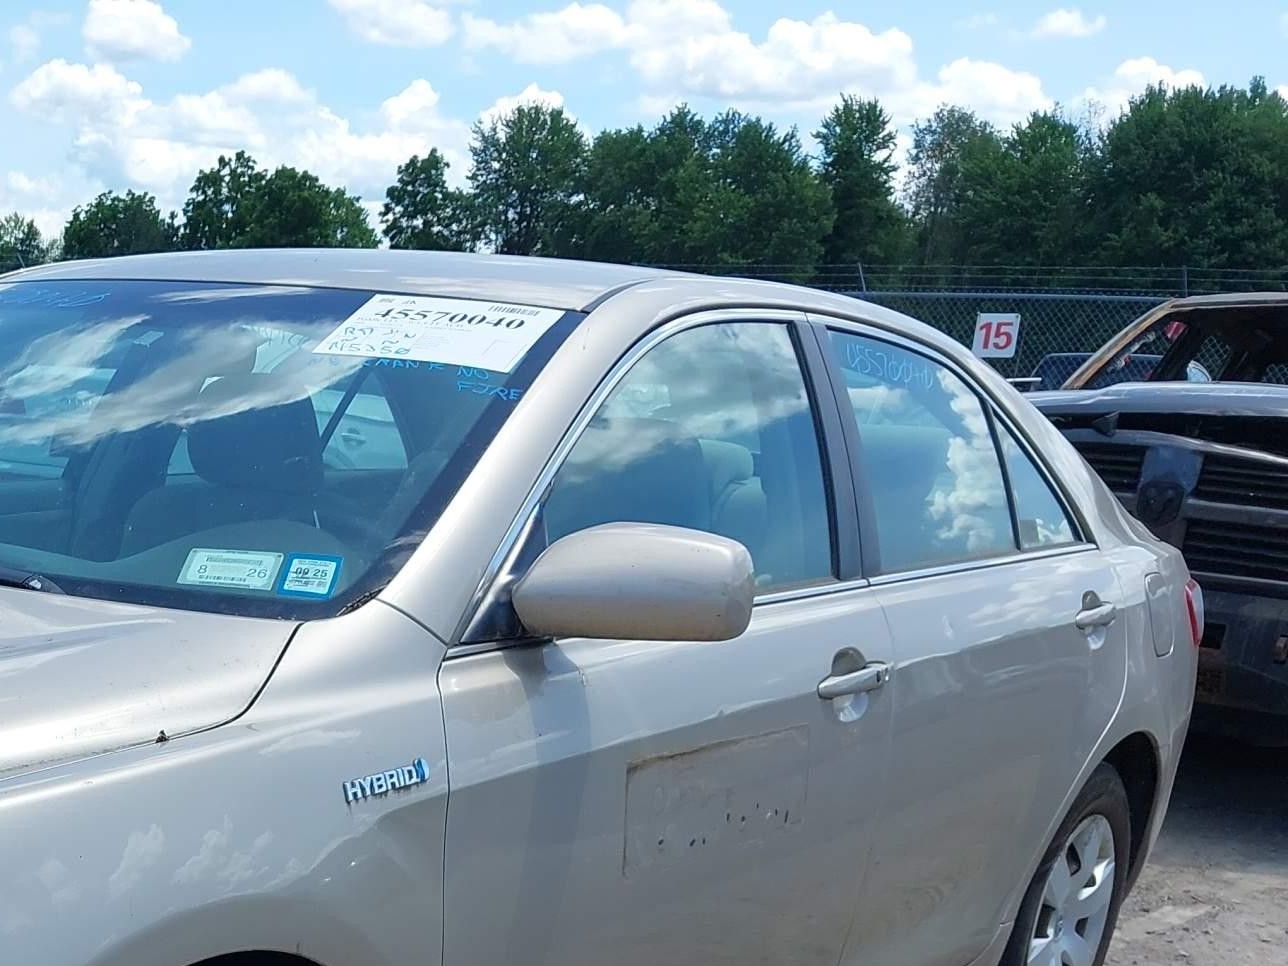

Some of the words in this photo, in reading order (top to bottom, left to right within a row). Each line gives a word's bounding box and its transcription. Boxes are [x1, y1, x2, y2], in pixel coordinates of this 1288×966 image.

[374, 307, 526, 330] 45570040
[979, 321, 1014, 350] 15
[457, 367, 489, 381] NO
[197, 564, 209, 575] 8
[246, 568, 269, 579] 26
[312, 568, 329, 578] 25
[343, 762, 421, 803] HYBRID
